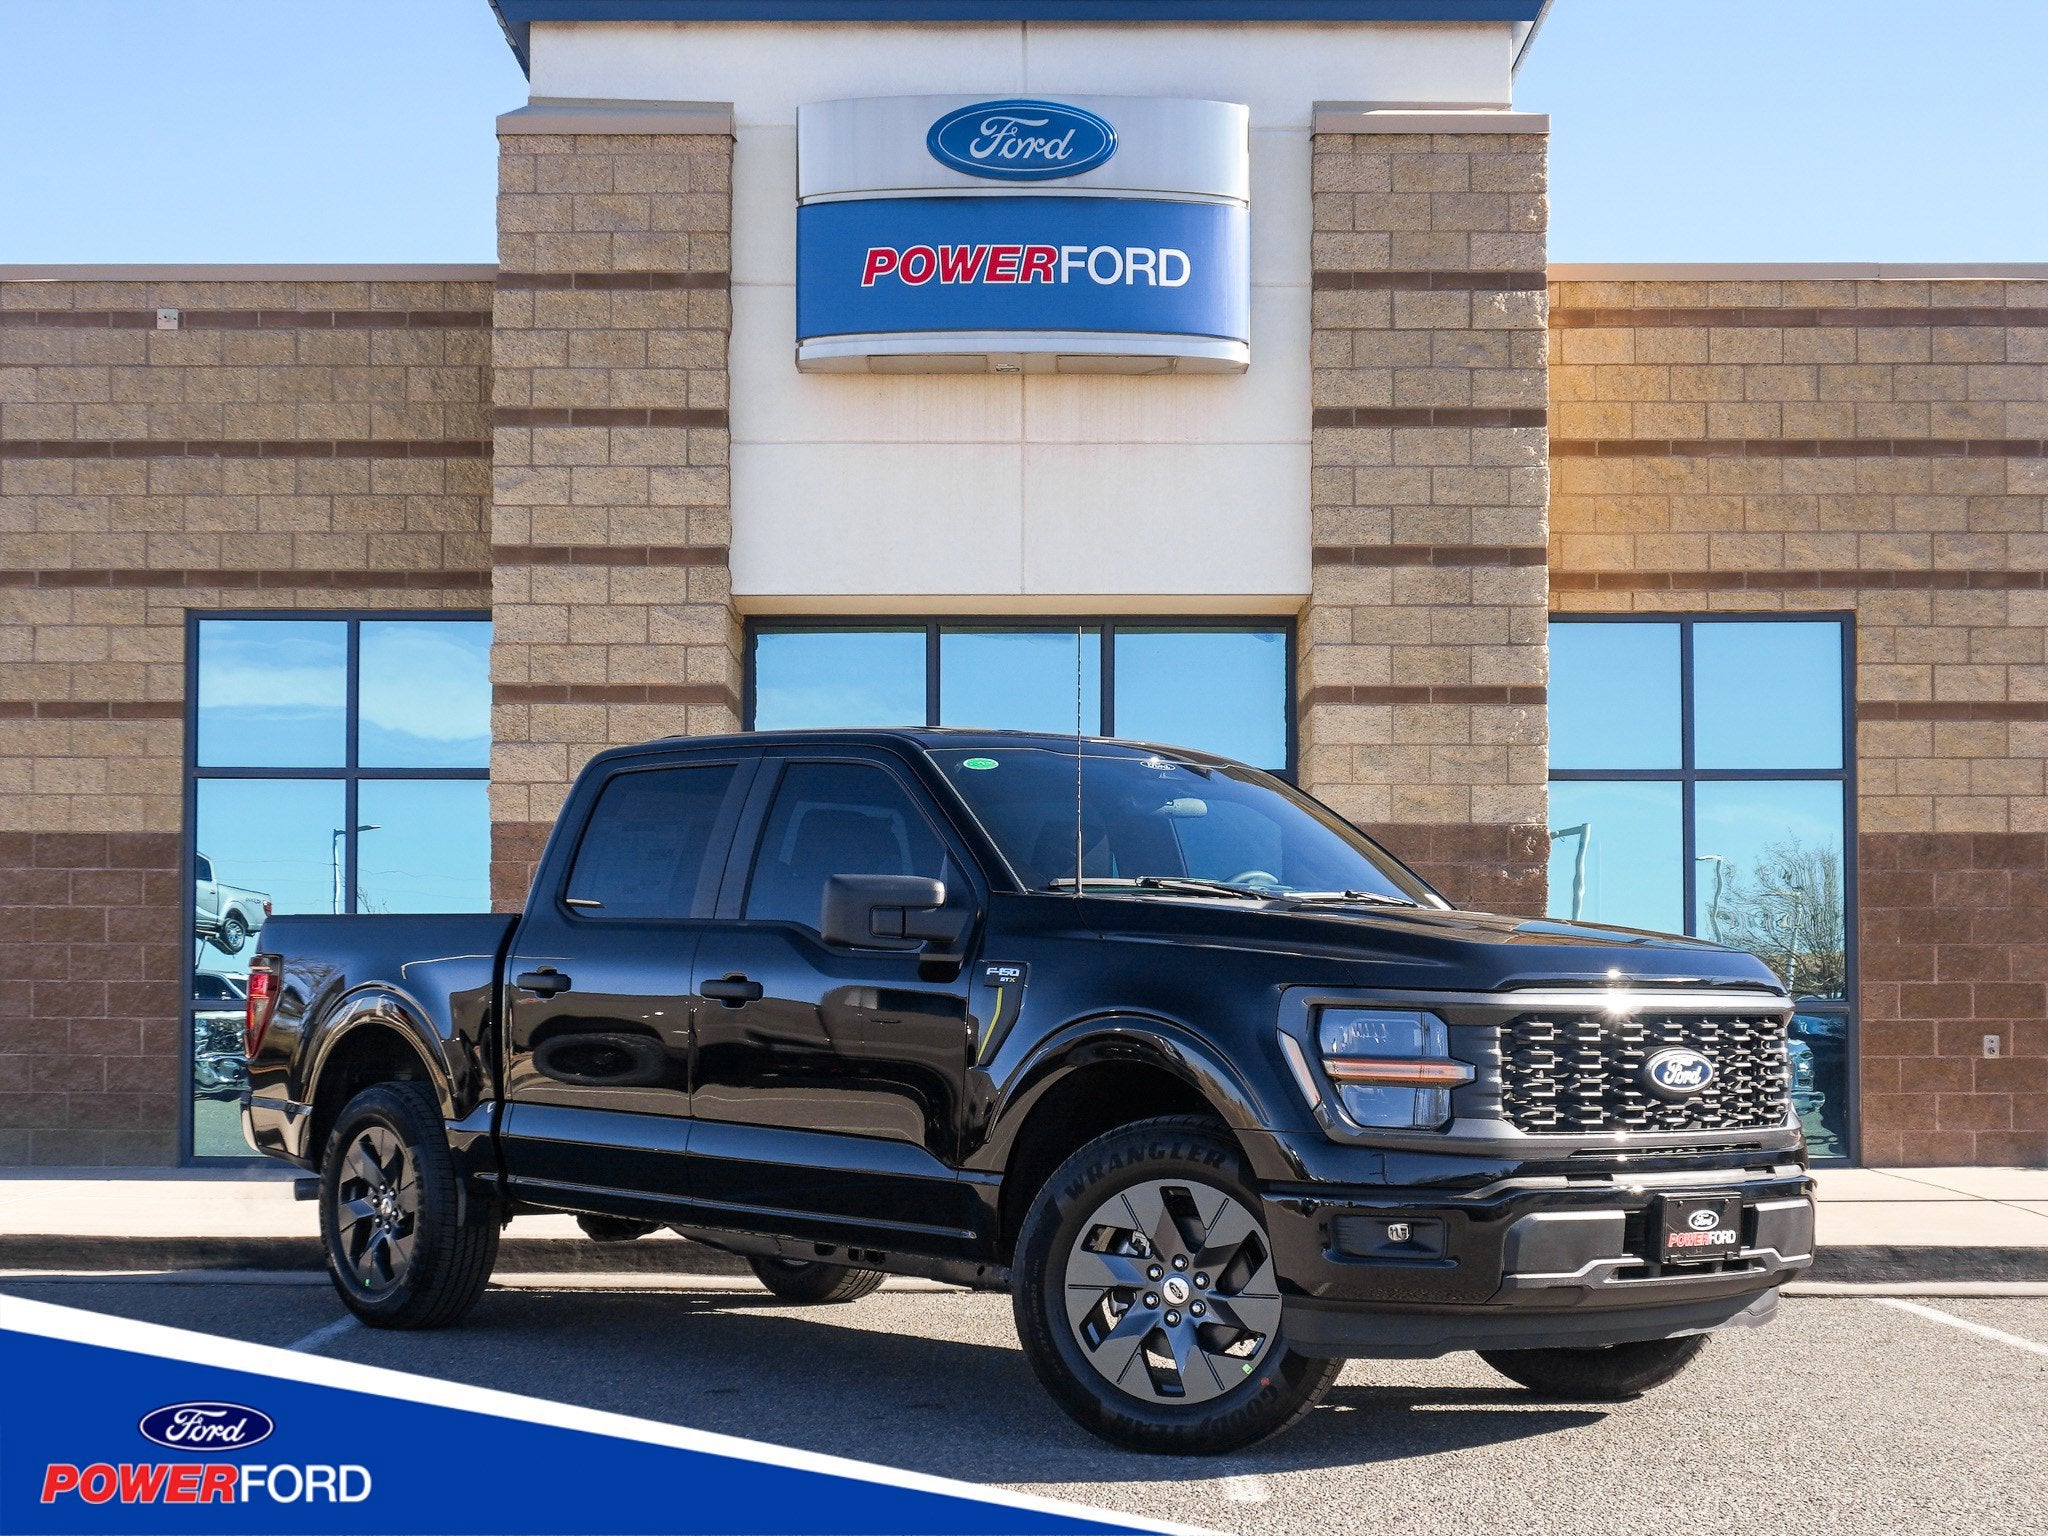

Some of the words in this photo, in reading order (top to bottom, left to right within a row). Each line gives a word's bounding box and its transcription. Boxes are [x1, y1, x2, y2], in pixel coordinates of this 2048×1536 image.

[969, 115, 1076, 160] Ford
[860, 244, 1192, 288] POWERFORD
[1662, 1058, 1703, 1085] Ford
[1063, 1141, 1226, 1201] WRANGLER
[1693, 1212, 1714, 1227] Ford
[1667, 1229, 1737, 1248] POWERFORD
